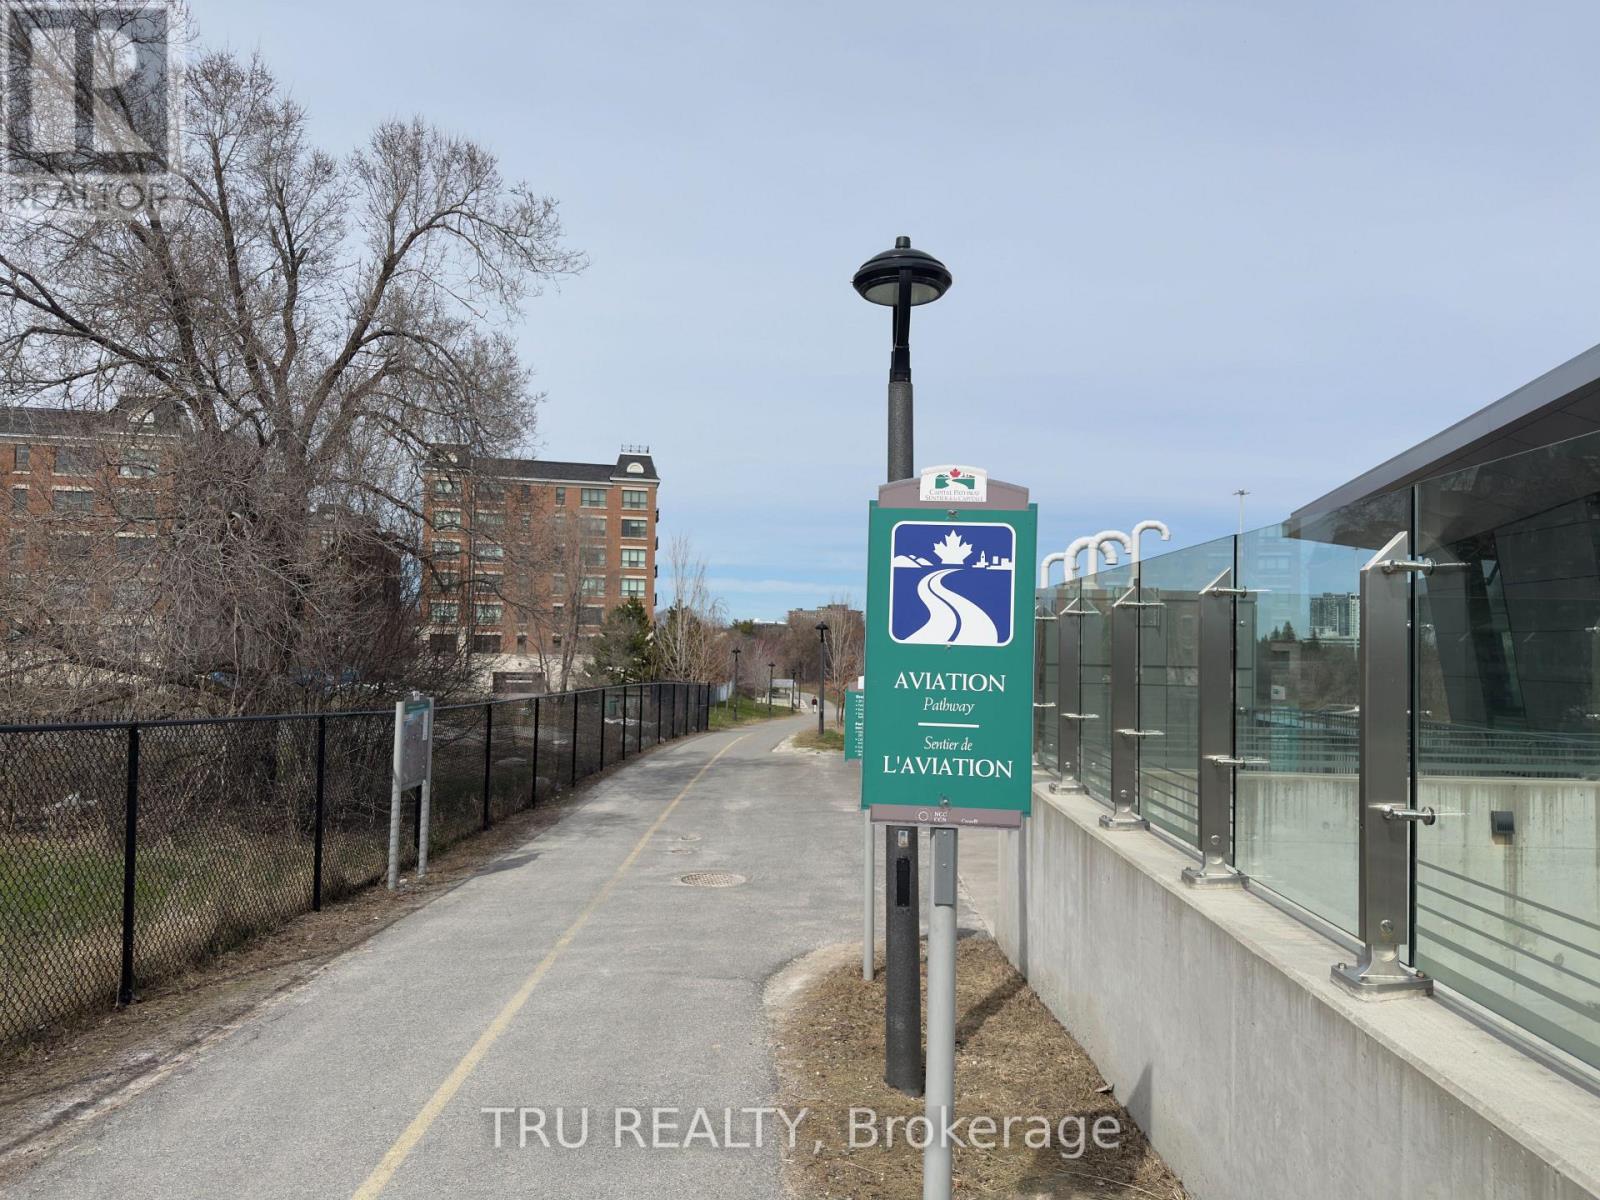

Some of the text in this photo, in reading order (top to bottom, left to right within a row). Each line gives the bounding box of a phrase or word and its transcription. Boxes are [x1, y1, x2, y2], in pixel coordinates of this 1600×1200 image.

[894, 672, 1006, 692] AVIATION
[923, 697, 975, 716] Pathway
[924, 736, 973, 751] Sentier de
[883, 755, 1013, 779] L'AVIATION
